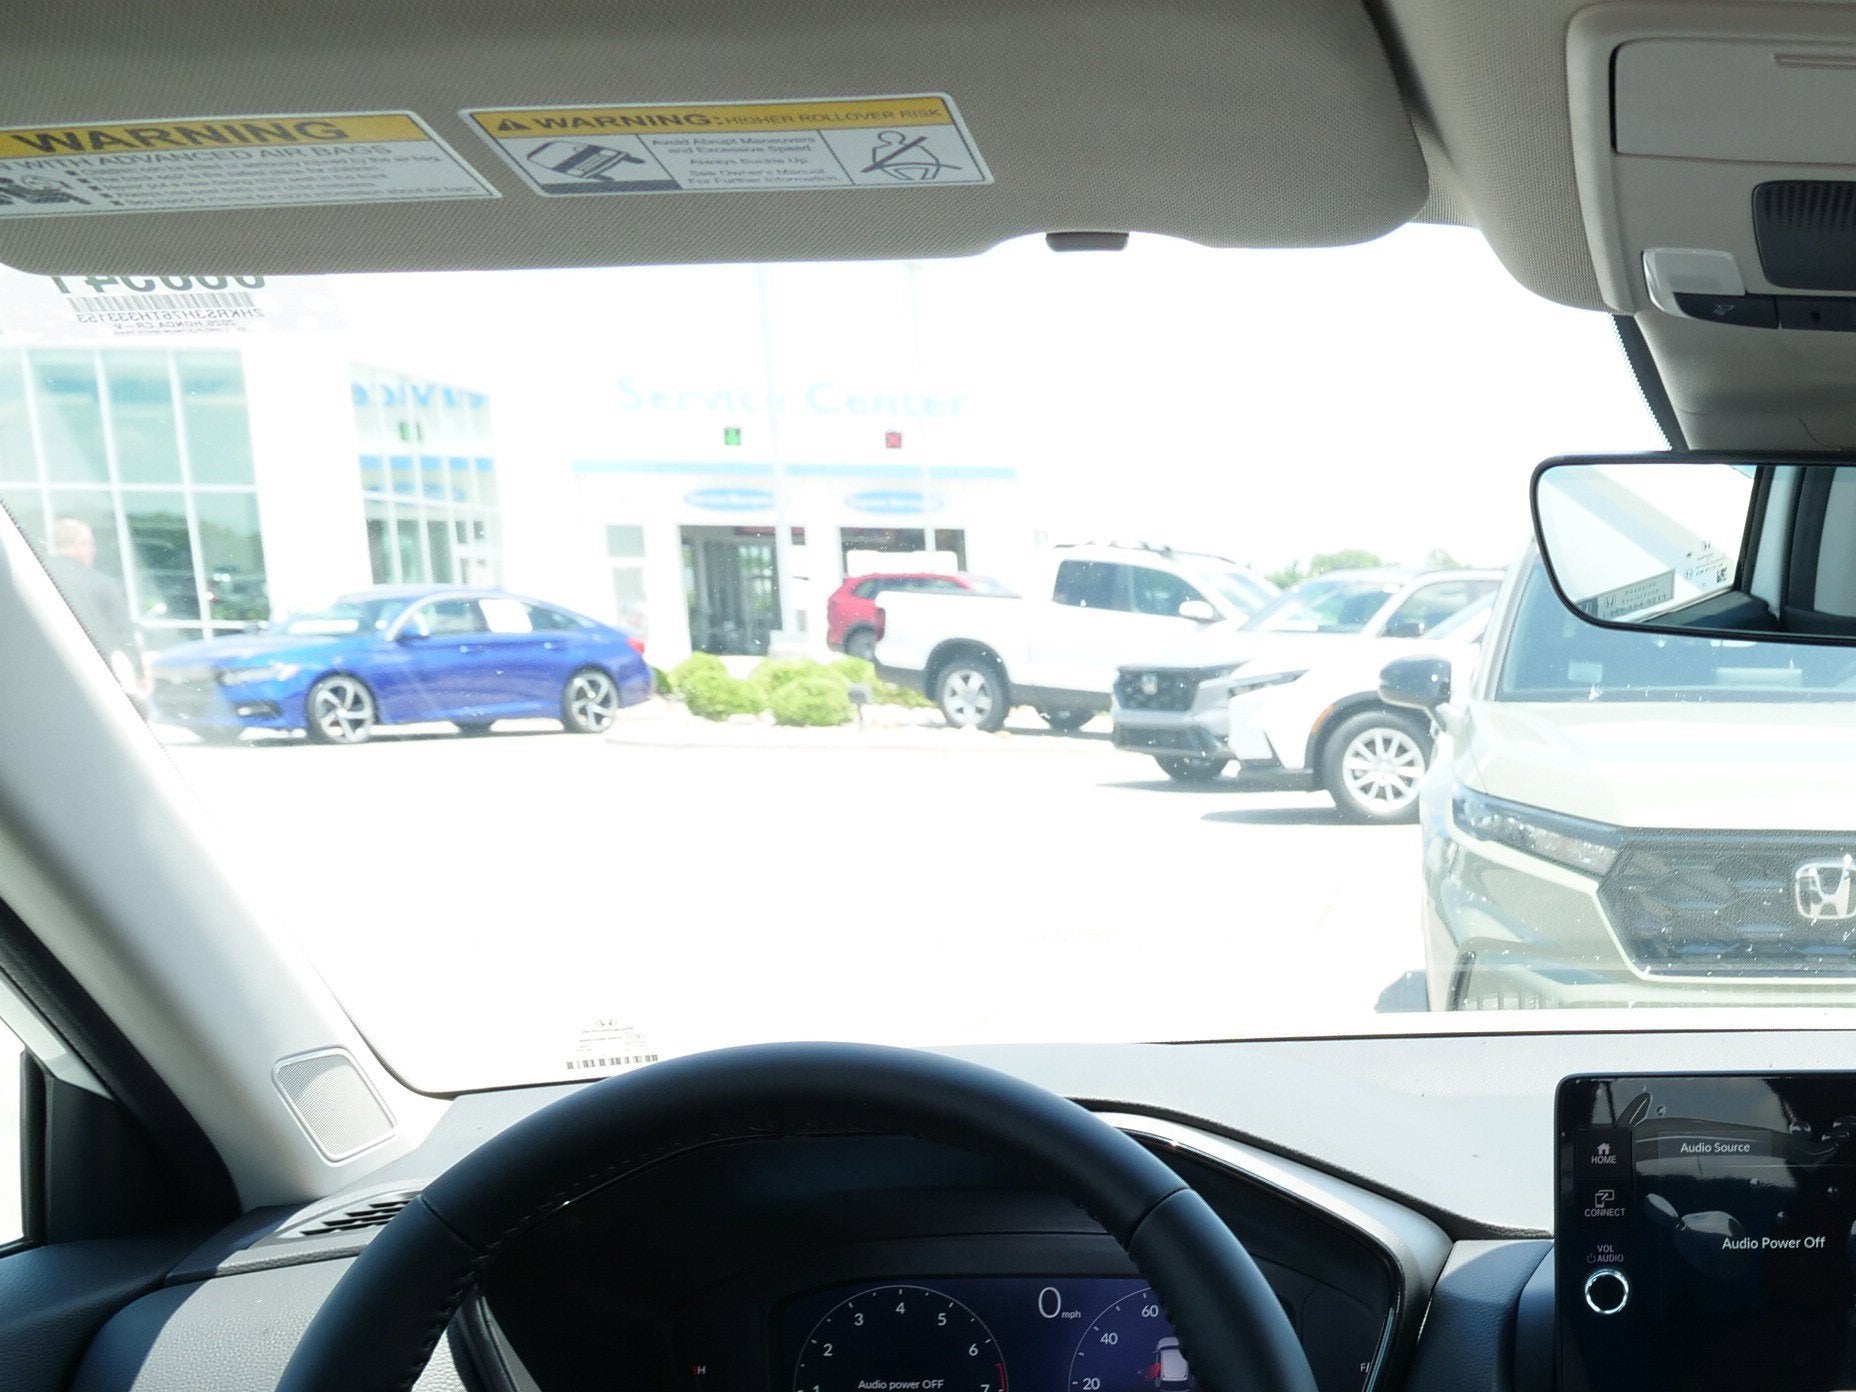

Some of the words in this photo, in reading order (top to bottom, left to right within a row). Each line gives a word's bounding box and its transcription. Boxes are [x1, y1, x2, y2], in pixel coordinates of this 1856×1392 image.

[533, 112, 724, 131] WARNING:
[726, 114, 795, 125] HIGHER
[800, 110, 895, 122] ROLLOVER
[900, 108, 940, 119] RISK
[10, 121, 349, 153] WARNING
[15, 157, 93, 169] WITH
[99, 150, 252, 165] ADVANCED
[260, 147, 306, 158] AIR
[310, 145, 392, 156] BAGS
[804, 381, 969, 418] Center
[1680, 1142, 1712, 1153] Audio
[1714, 1142, 1750, 1153] Source
[1591, 1155, 1617, 1164] HOME
[1584, 1208, 1626, 1217] CONNECT
[1597, 1244, 1615, 1253] VOL
[1722, 1237, 1758, 1250] Audio
[1762, 1237, 1800, 1249] Power
[1804, 1236, 1826, 1248] Off
[1597, 1254, 1624, 1263] AUDIO
[895, 1302, 905, 1315] 4
[1038, 1286, 1062, 1318] 0
[1061, 1310, 1082, 1320] mph
[1141, 1305, 1159, 1318] 60
[854, 1313, 864, 1326] 3
[937, 1313, 947, 1326] 5
[1100, 1332, 1118, 1345] 40
[823, 1343, 833, 1357] 2
[969, 1343, 979, 1356] 6
[858, 1379, 887, 1389] Audio
[889, 1381, 920, 1391] power
[922, 1379, 945, 1389] OFF
[1082, 1377, 1100, 1391] 20
